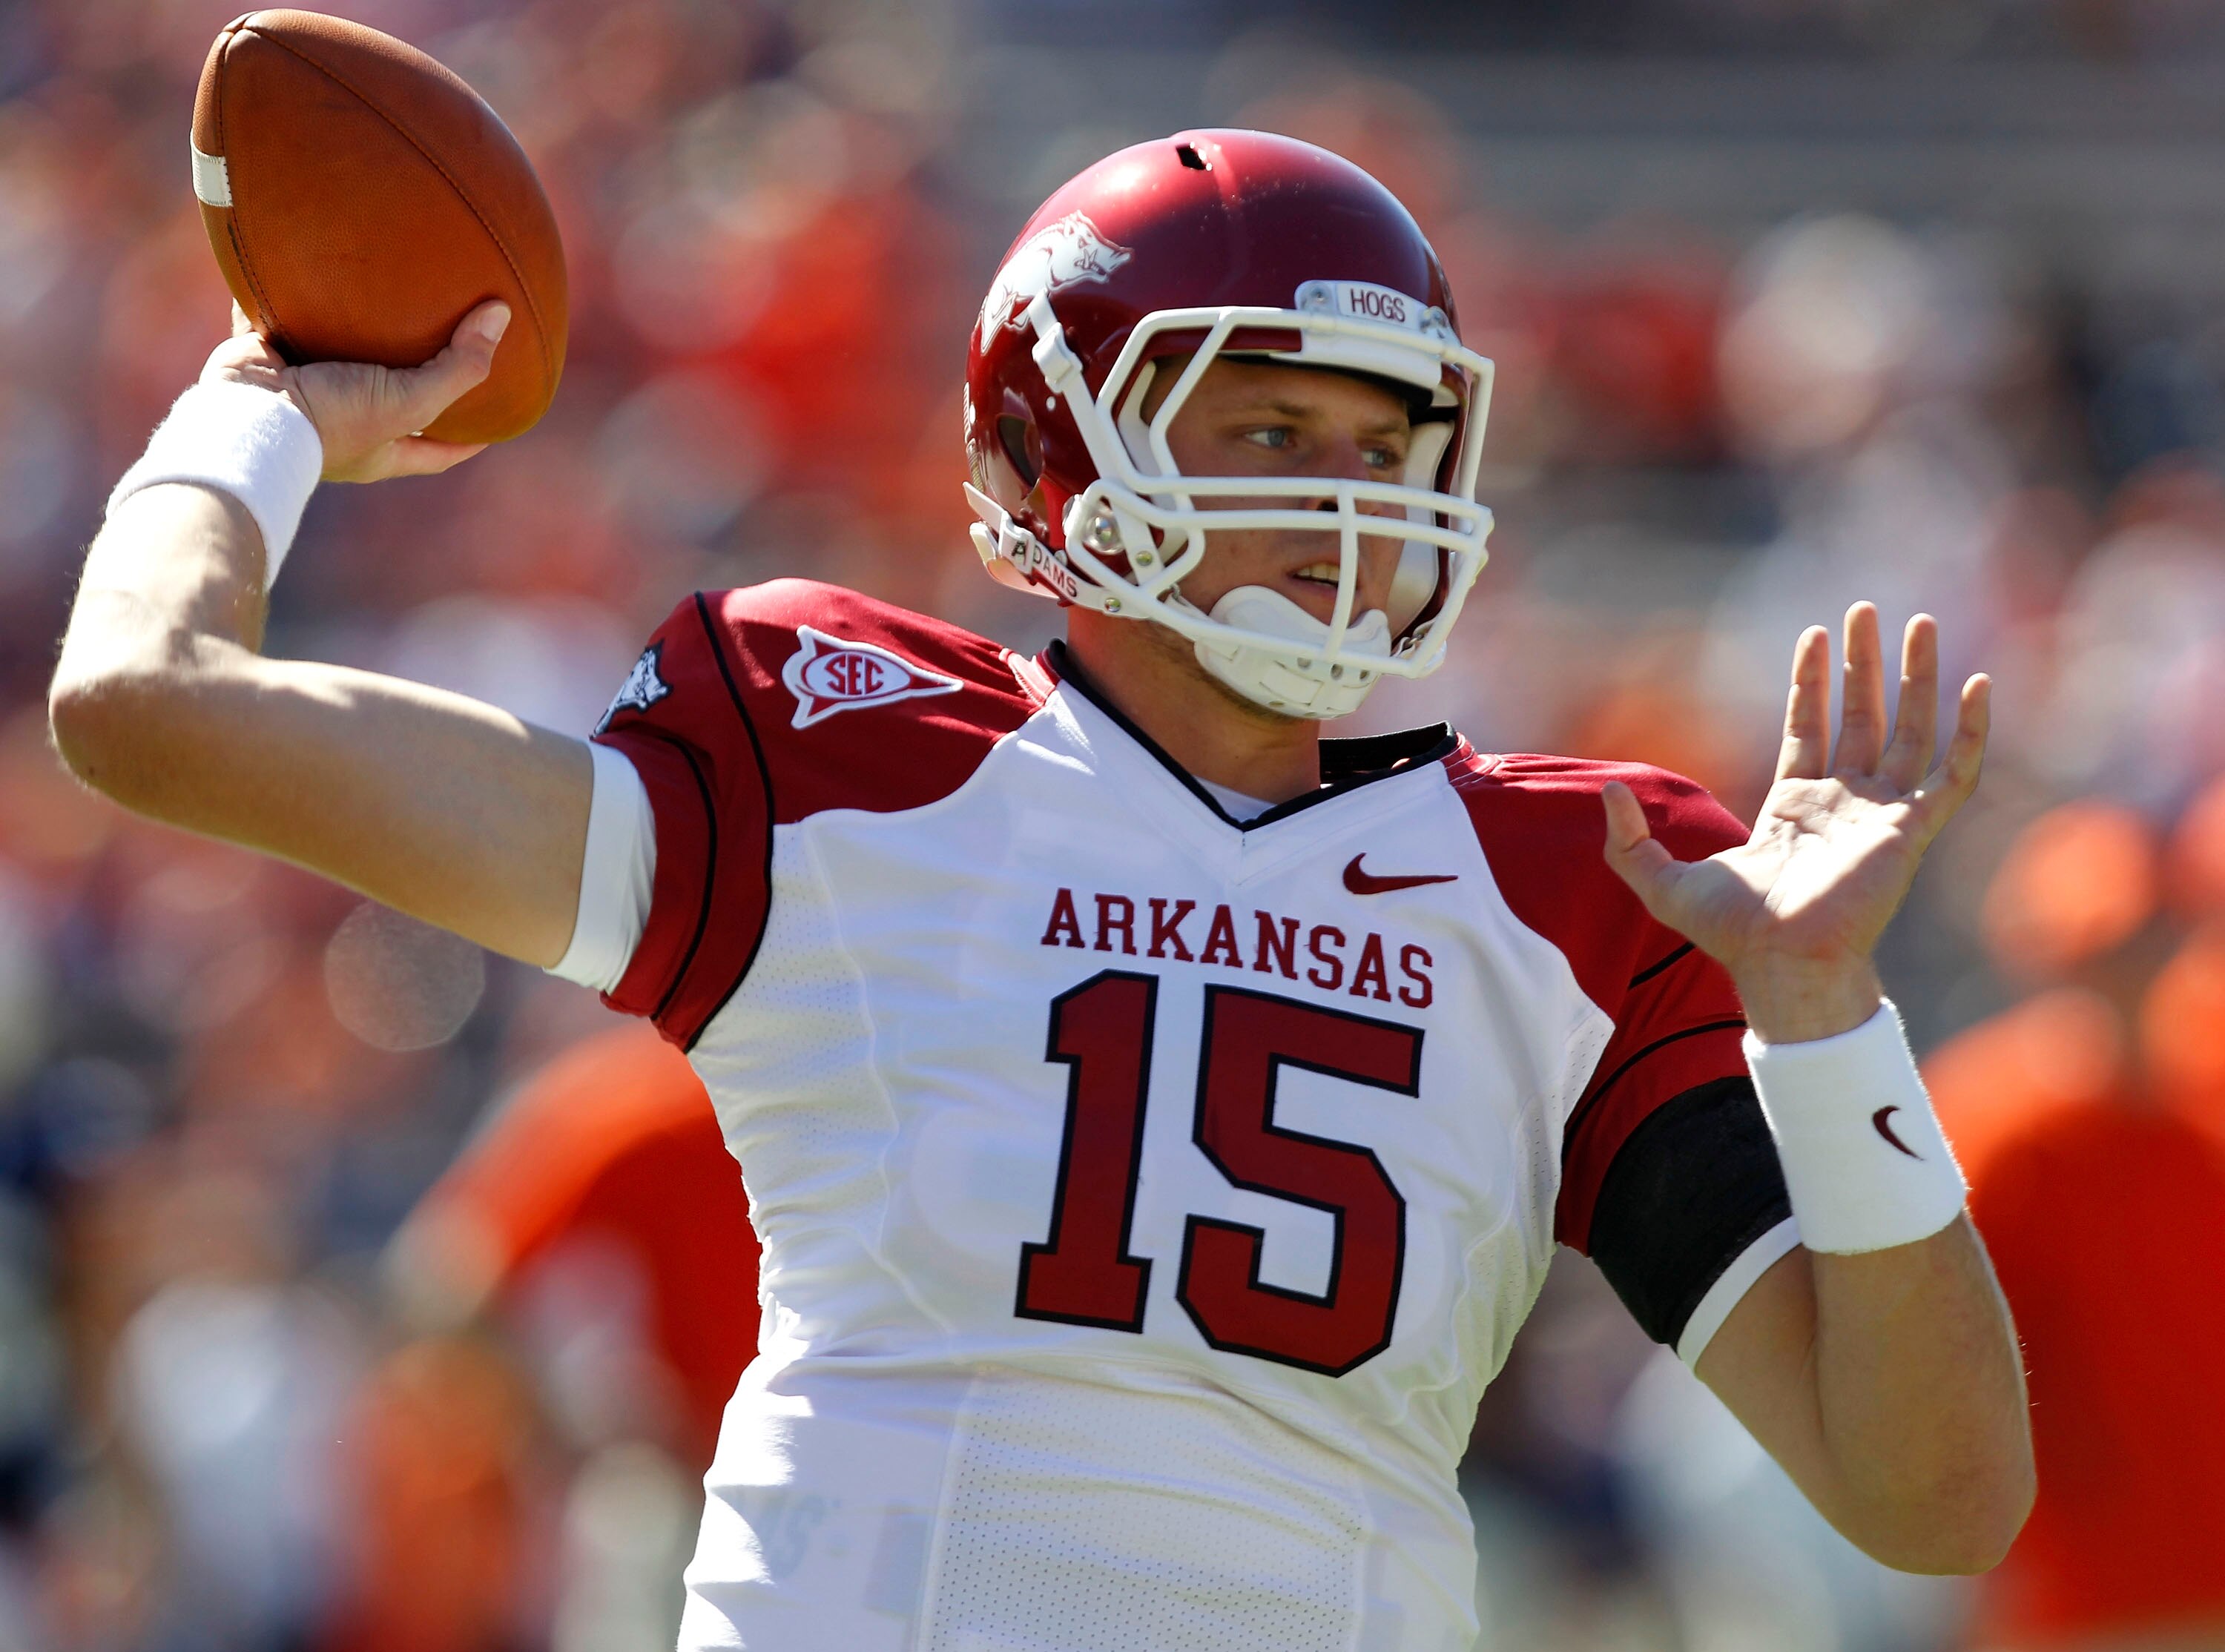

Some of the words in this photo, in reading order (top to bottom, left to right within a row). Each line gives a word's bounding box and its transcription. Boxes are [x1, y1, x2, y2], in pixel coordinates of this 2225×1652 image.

[1350, 288, 1406, 323] HOGS
[1011, 541, 1078, 598] ADAMS
[824, 653, 884, 696] SEC
[1041, 888, 1433, 1008] ARKANSAS
[1014, 968, 1425, 1378] 15
